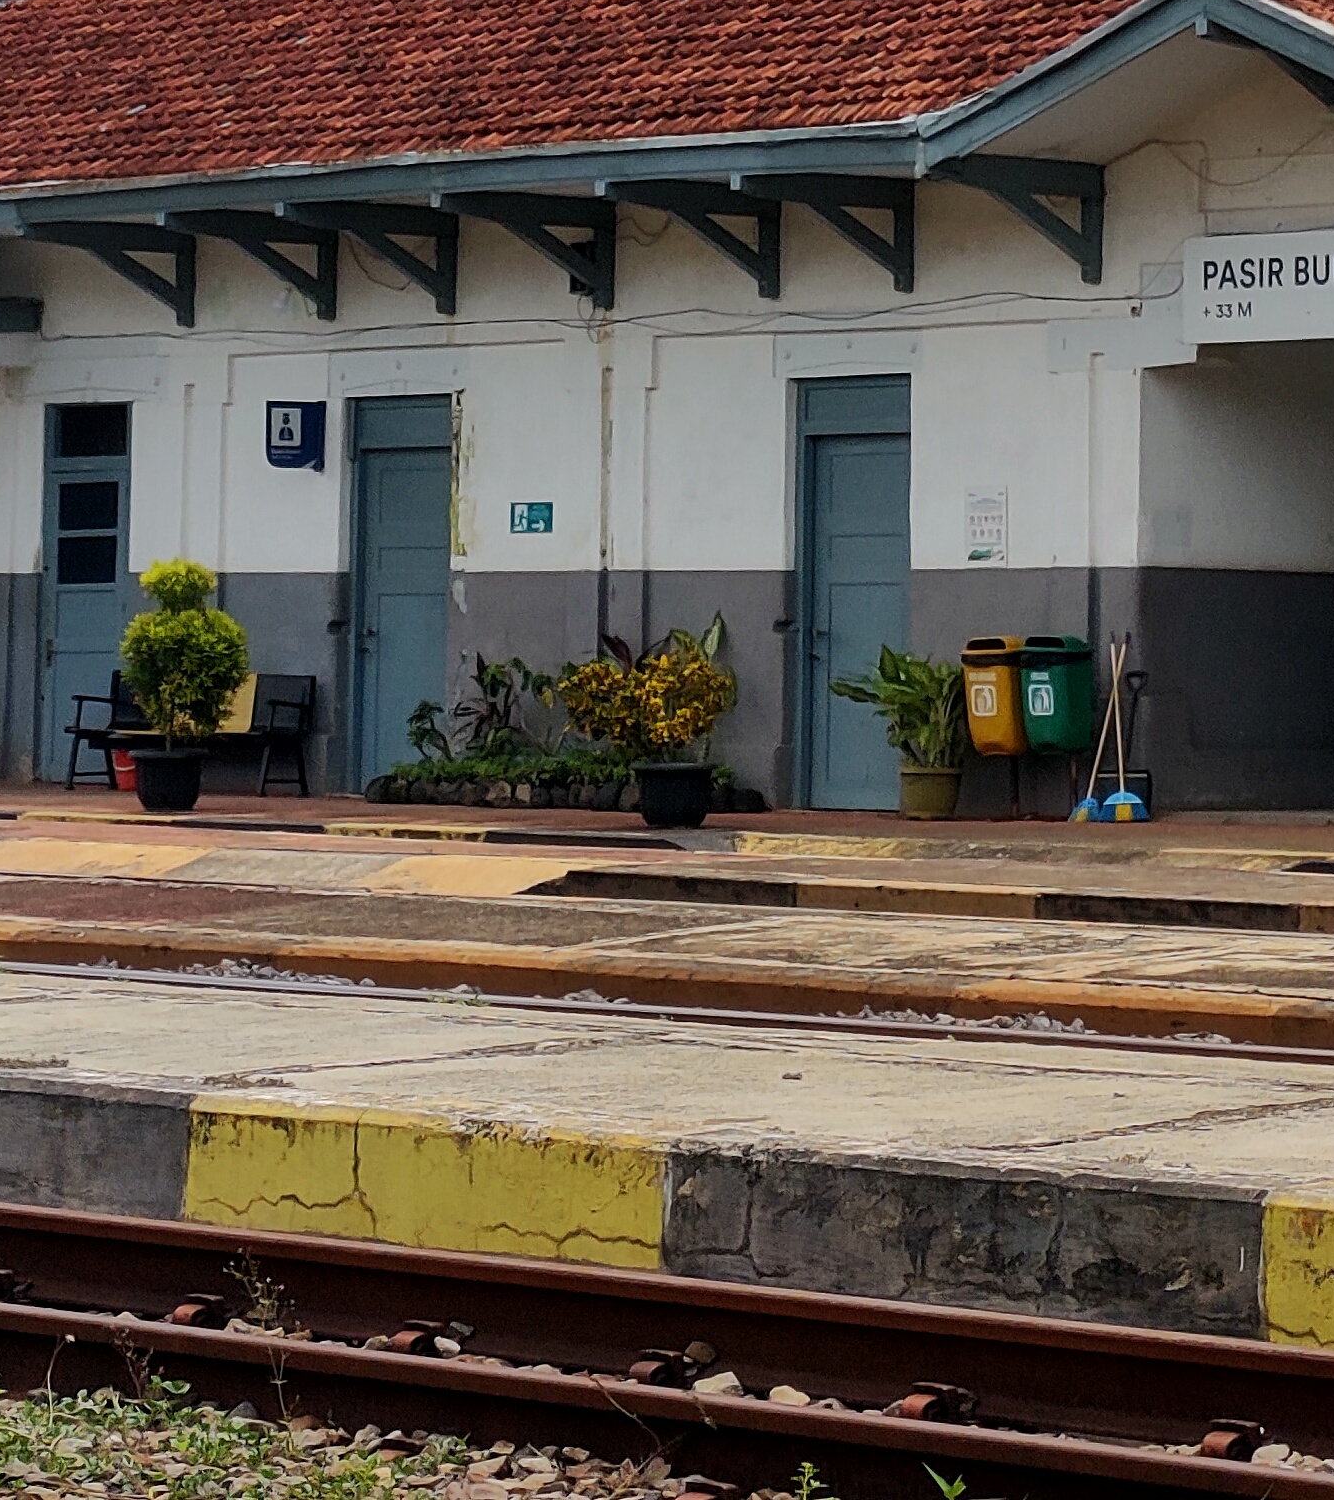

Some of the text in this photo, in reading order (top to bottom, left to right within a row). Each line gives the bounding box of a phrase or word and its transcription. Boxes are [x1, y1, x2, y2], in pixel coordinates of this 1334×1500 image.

[1203, 258, 1284, 290] PASIR
[1216, 303, 1232, 318] 33
[1238, 301, 1252, 318] M
